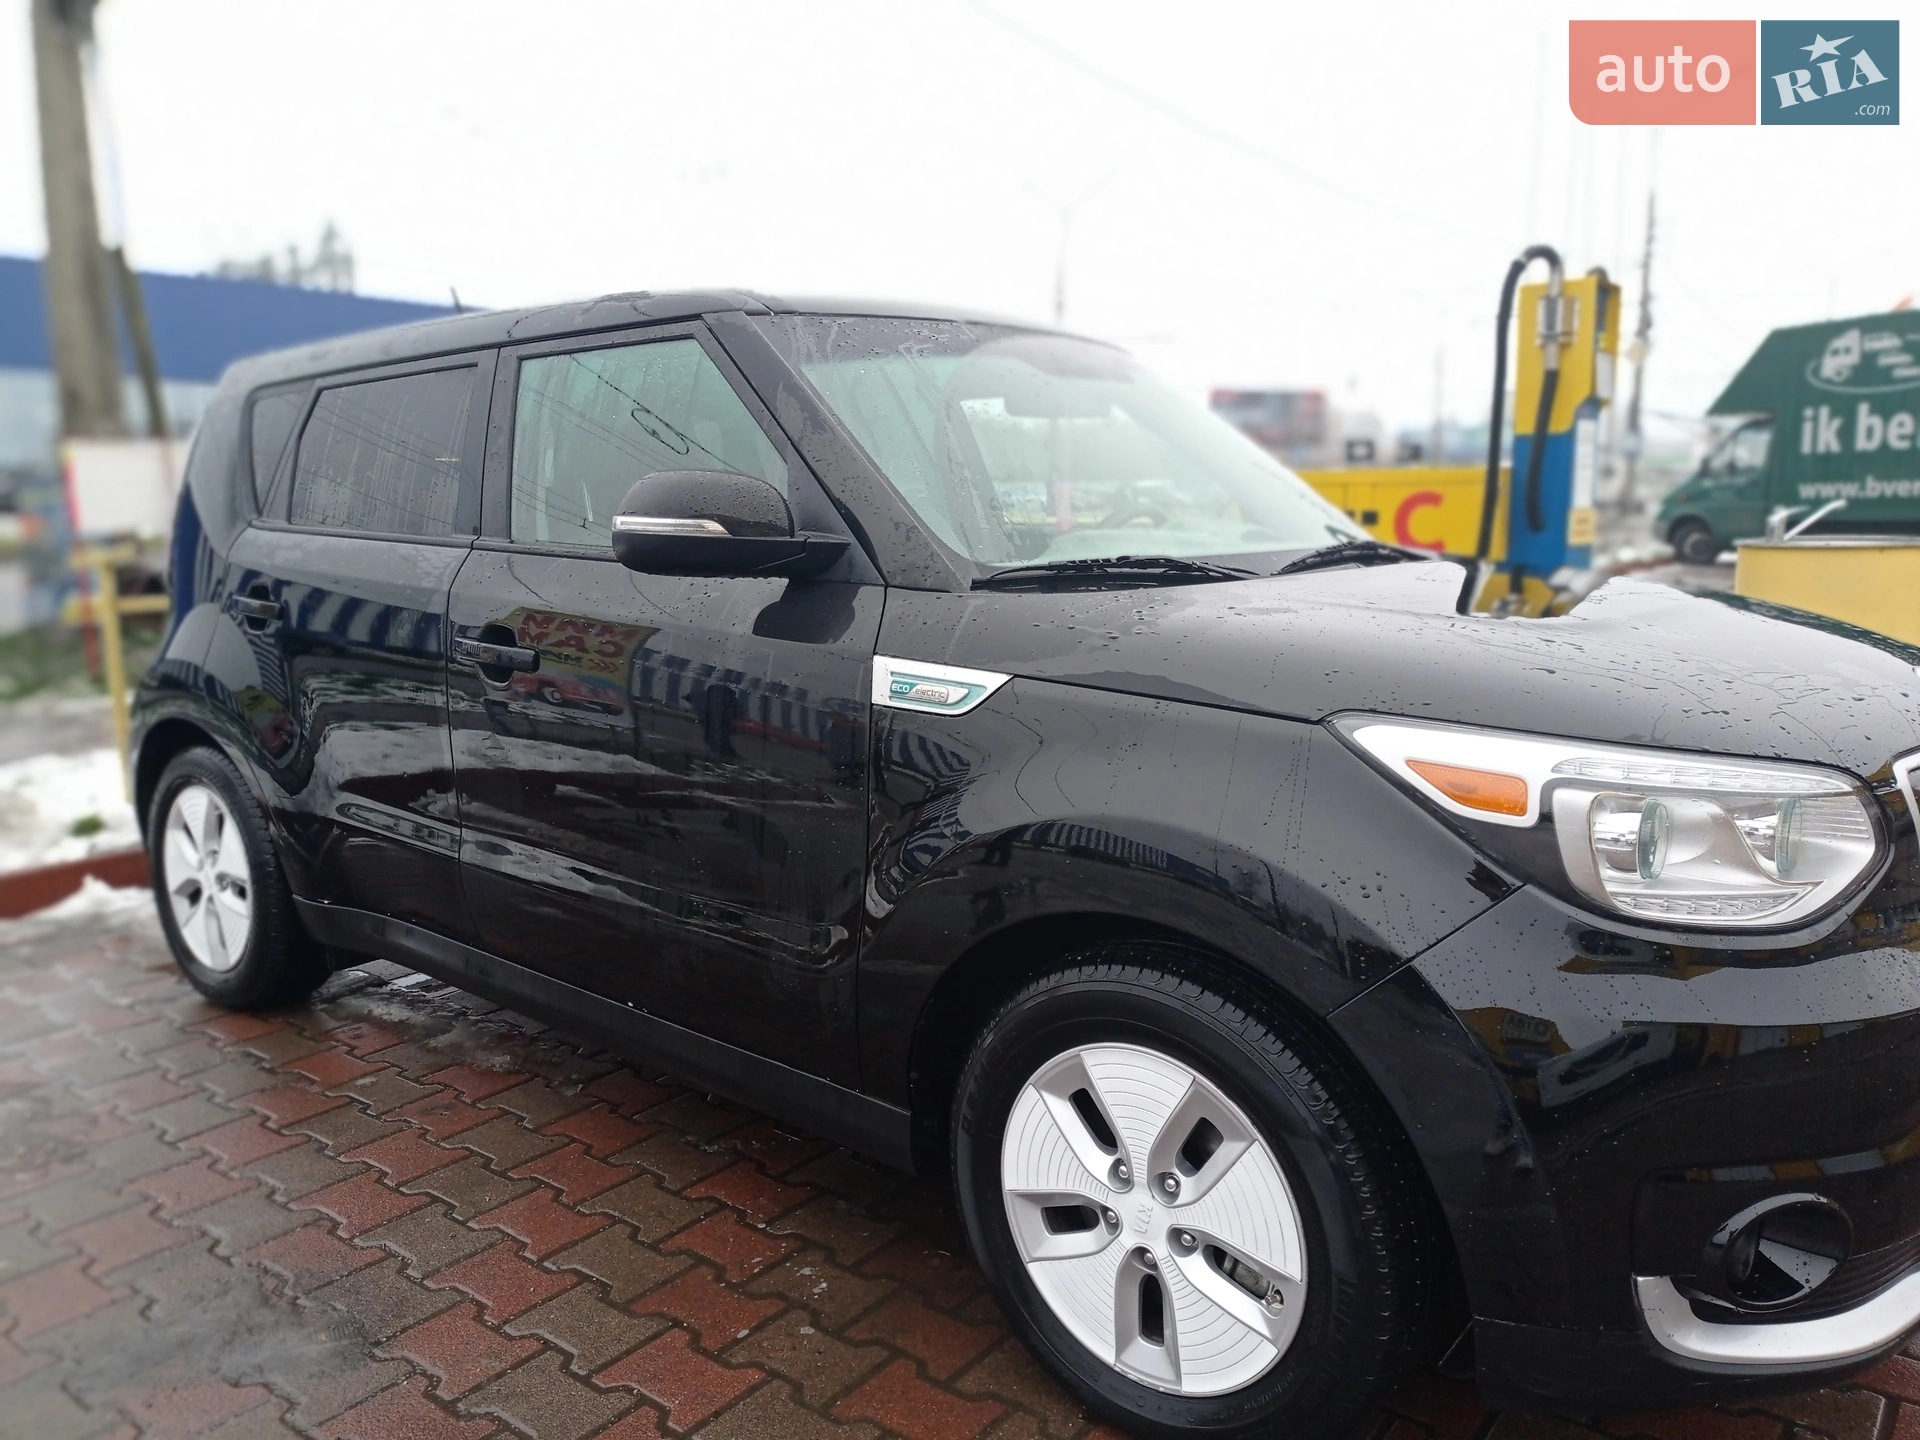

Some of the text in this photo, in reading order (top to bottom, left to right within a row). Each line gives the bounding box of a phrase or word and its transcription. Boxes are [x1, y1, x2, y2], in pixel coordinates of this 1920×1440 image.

[1801, 401, 1920, 454] ik be
[891, 683, 946, 698] ECO electric
